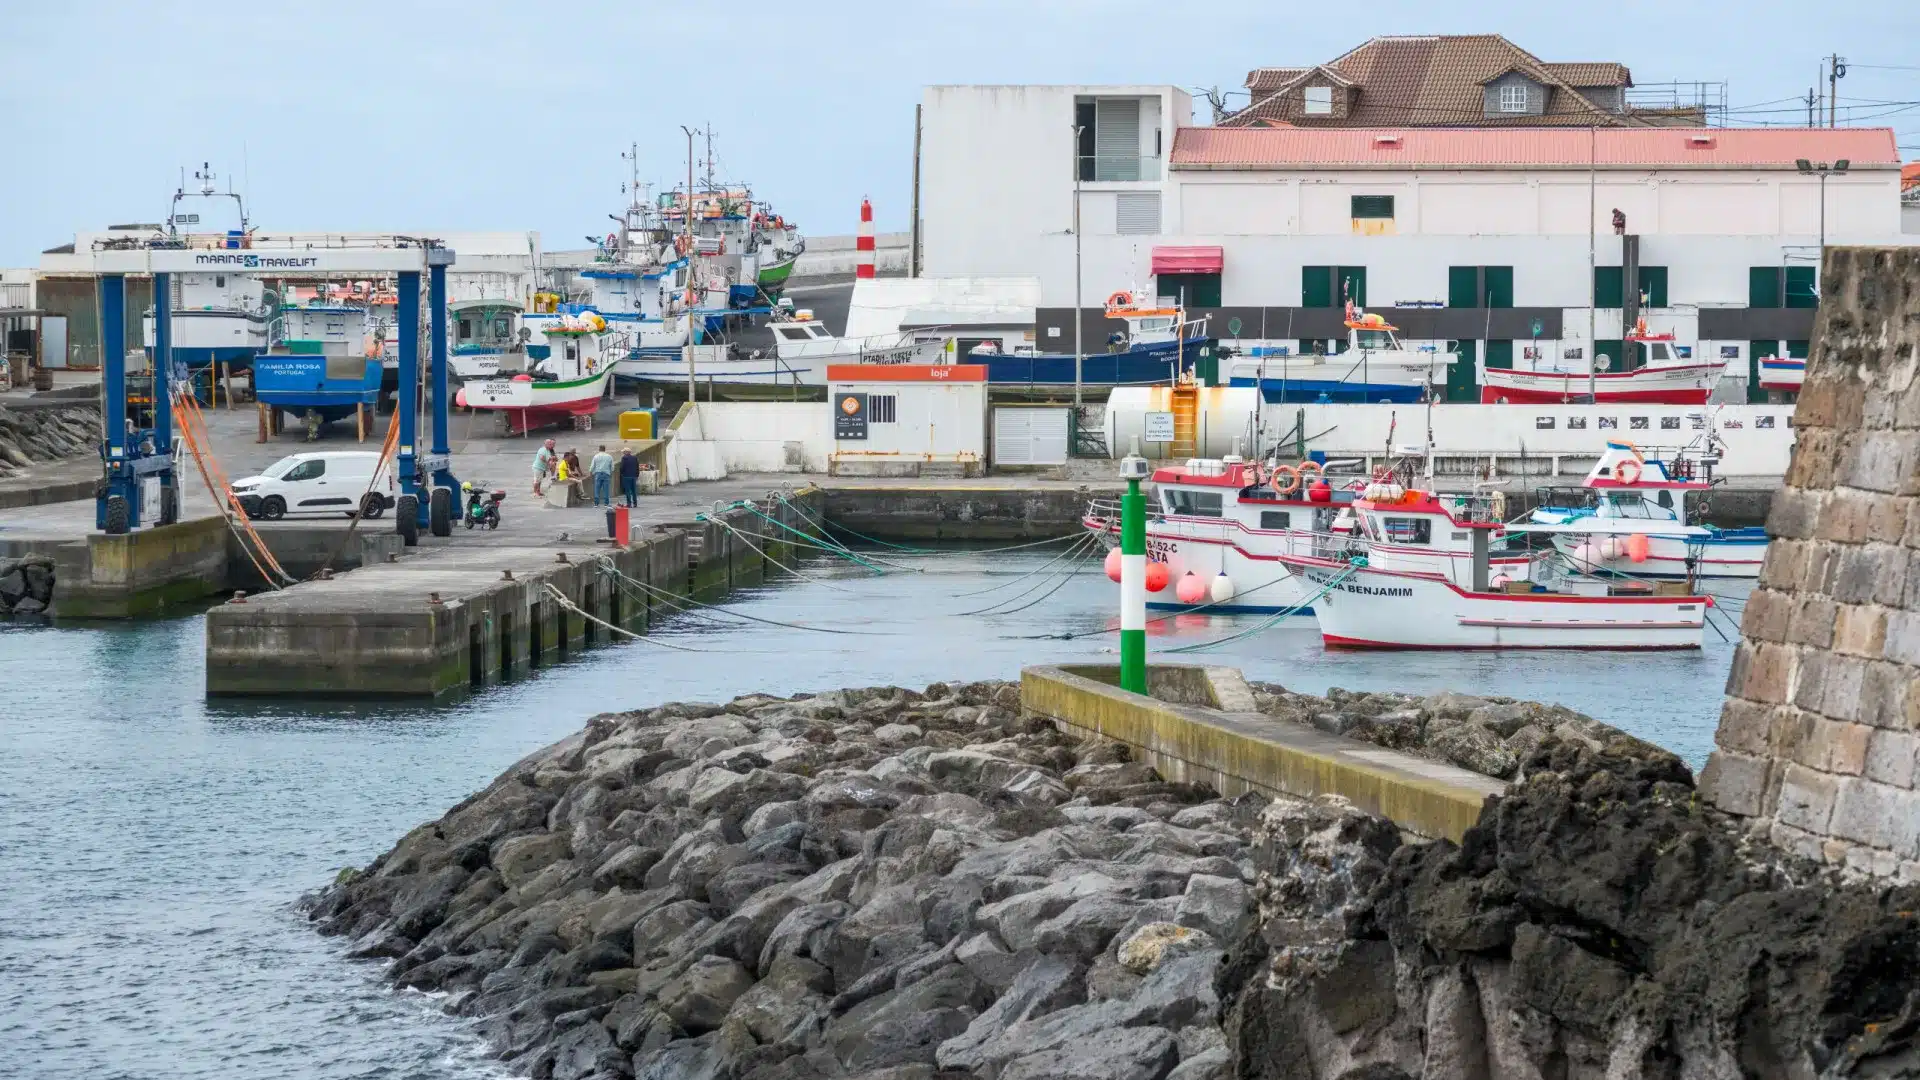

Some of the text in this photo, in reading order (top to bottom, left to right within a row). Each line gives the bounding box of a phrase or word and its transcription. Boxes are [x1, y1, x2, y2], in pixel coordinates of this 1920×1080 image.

[196, 255, 243, 264] MARINE
[259, 258, 317, 267] TRAVELIFT
[930, 367, 949, 379] loja
[1348, 584, 1413, 597] BENJAMIM
